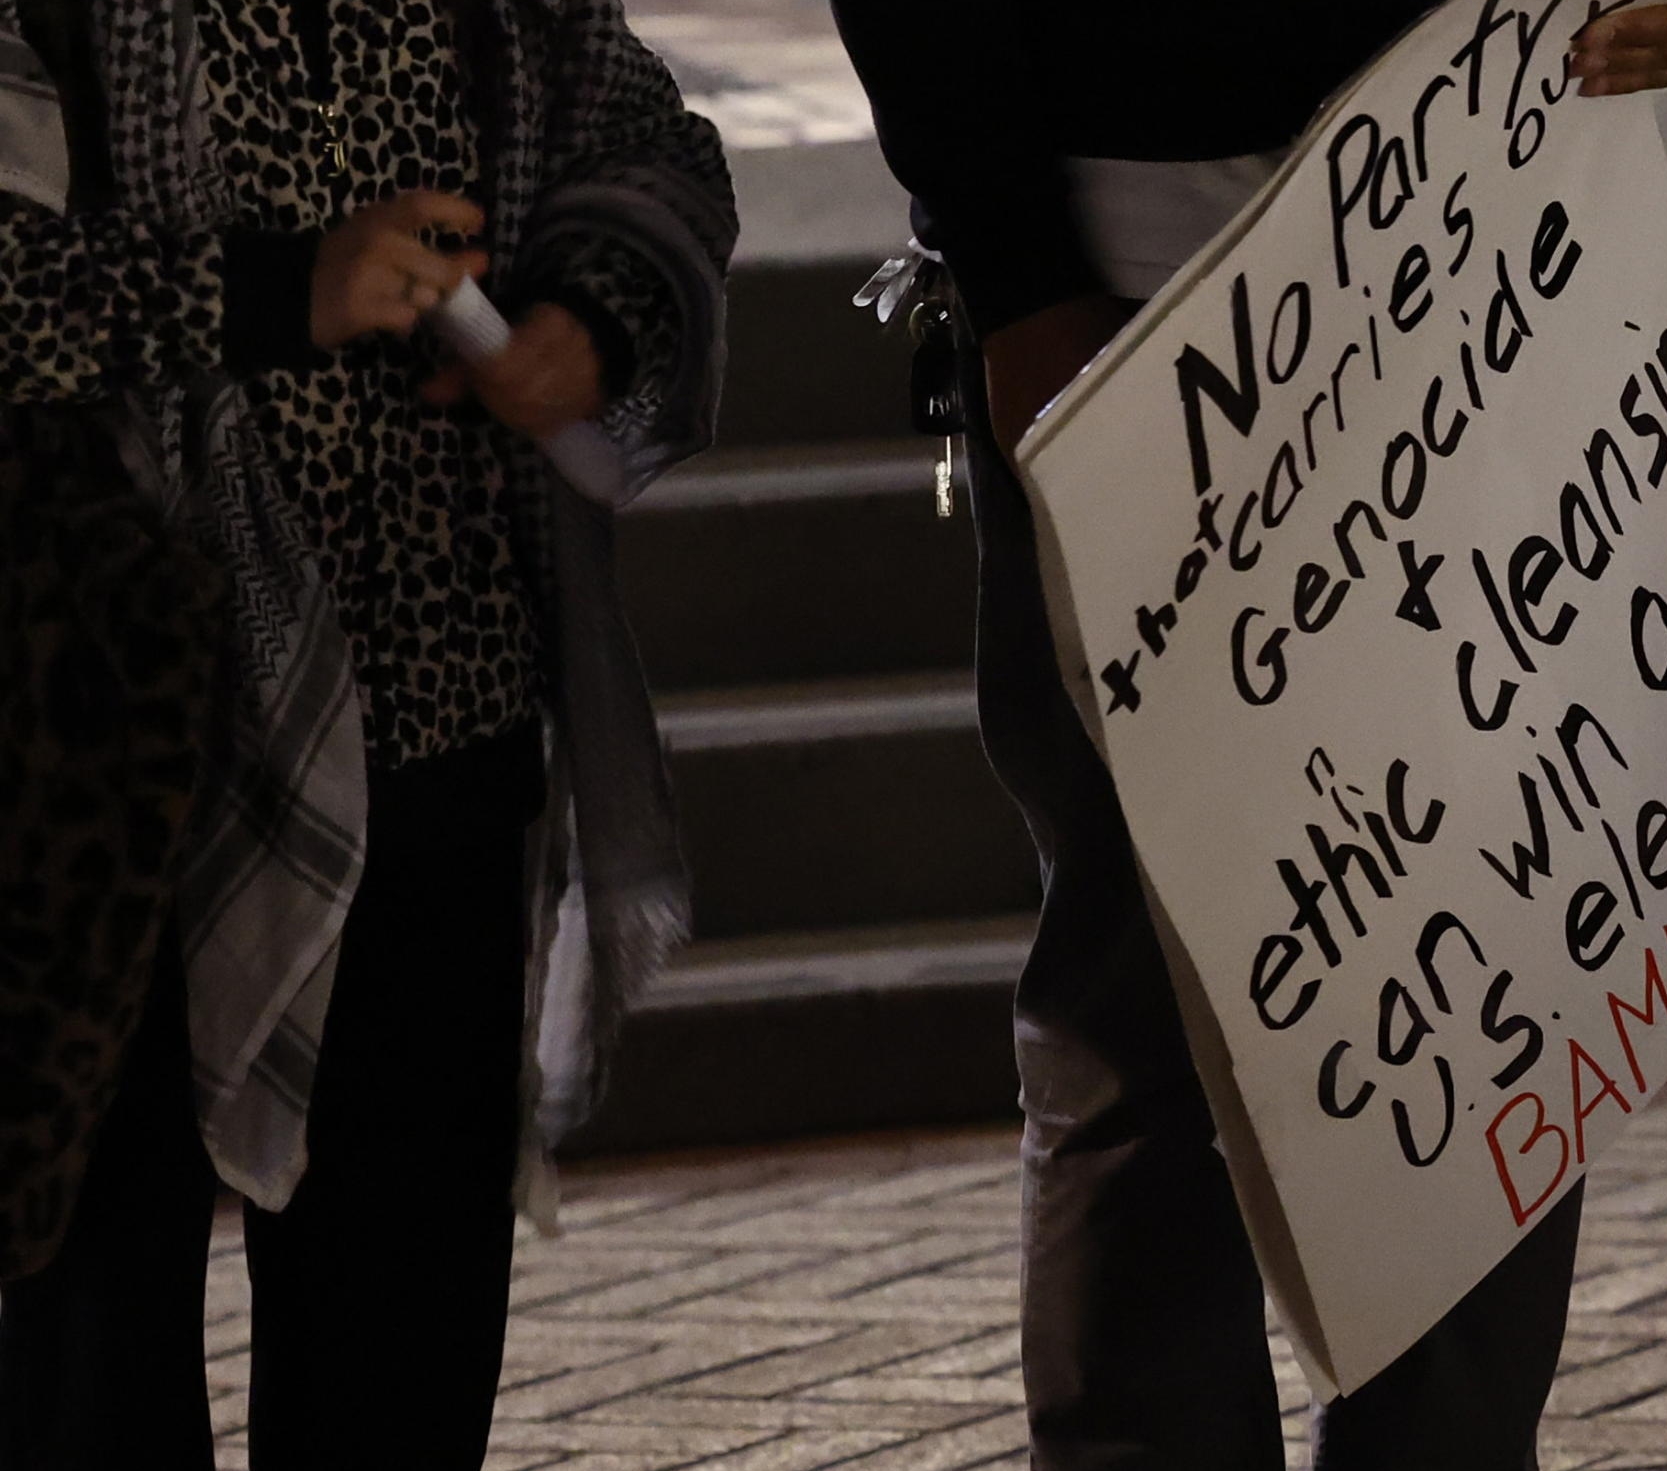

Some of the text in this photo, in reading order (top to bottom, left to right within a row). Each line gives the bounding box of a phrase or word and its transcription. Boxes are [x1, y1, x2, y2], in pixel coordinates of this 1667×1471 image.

[1099, 492, 1225, 716] that
[1230, 172, 1476, 571] carries
[1174, 274, 1311, 497] No
[1229, 199, 1584, 707] Genocide
[1317, 910, 1487, 1119] can
[1478, 702, 1629, 901] win
[1391, 969, 1562, 1168] U.S.
